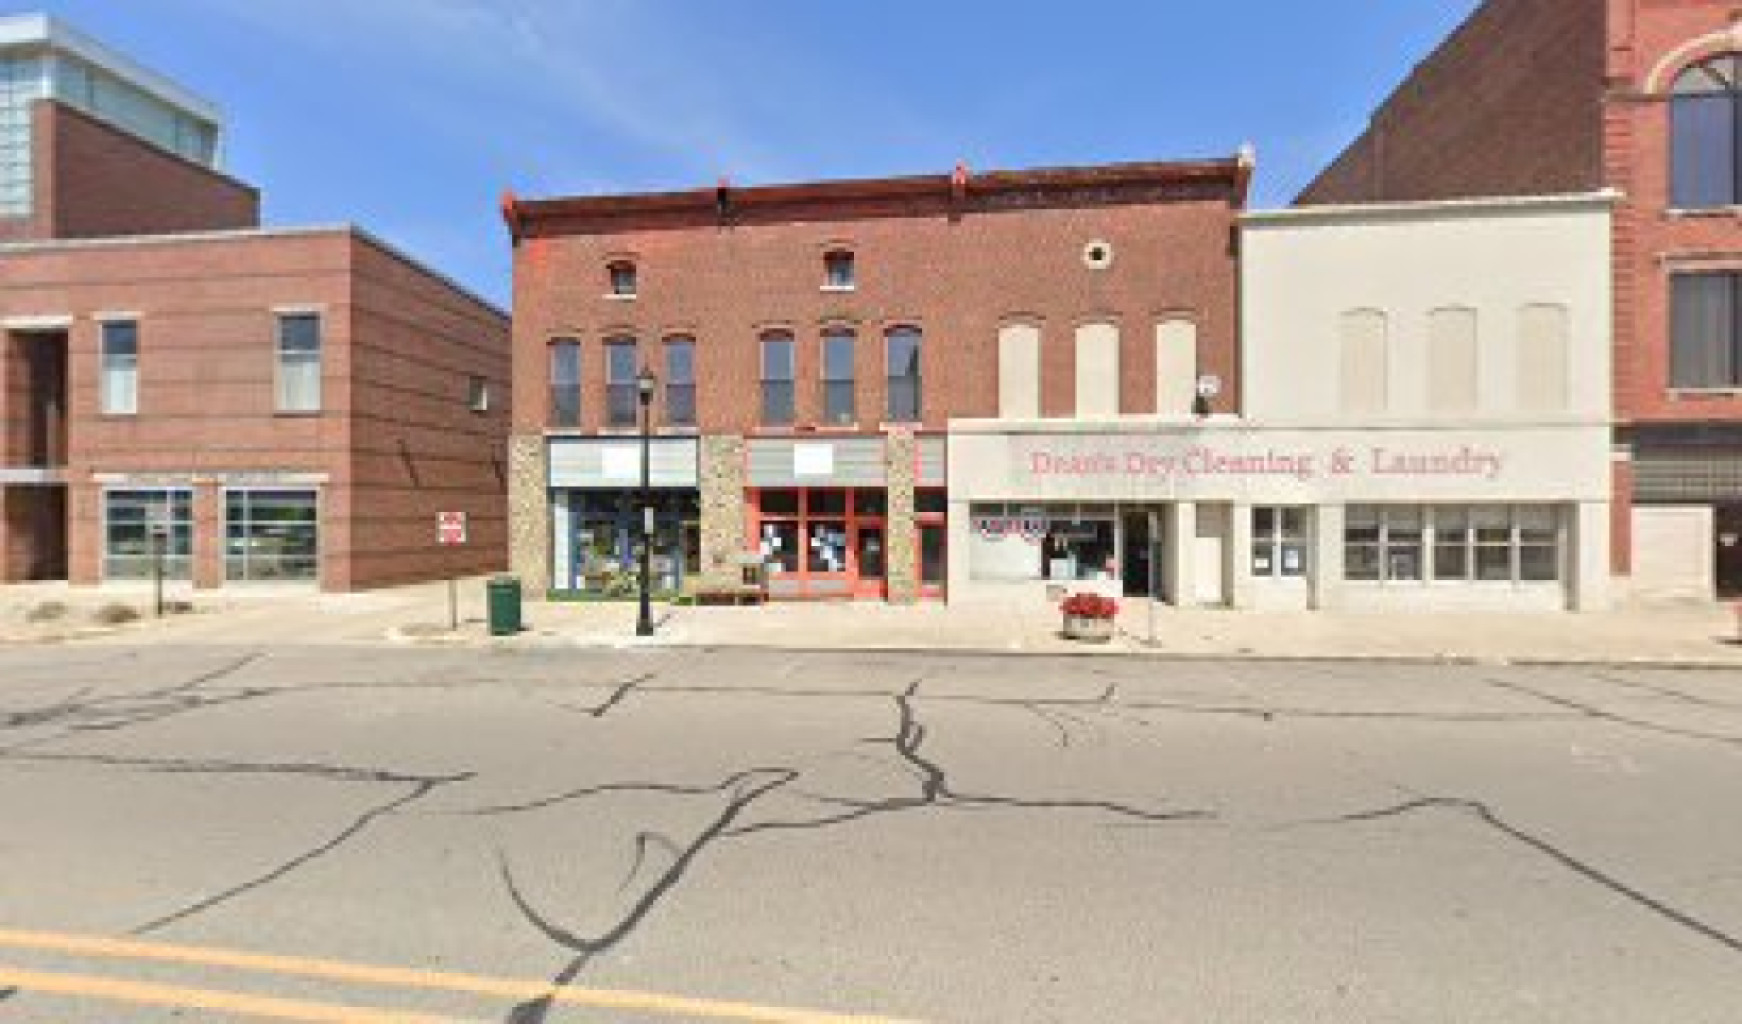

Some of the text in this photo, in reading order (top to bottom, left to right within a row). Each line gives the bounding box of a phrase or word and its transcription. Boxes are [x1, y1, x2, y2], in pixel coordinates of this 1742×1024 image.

[1126, 451, 1174, 480] Dry
[1182, 446, 1314, 480] Cleaning
[1331, 449, 1354, 474] &
[1371, 446, 1502, 480] Laundry
